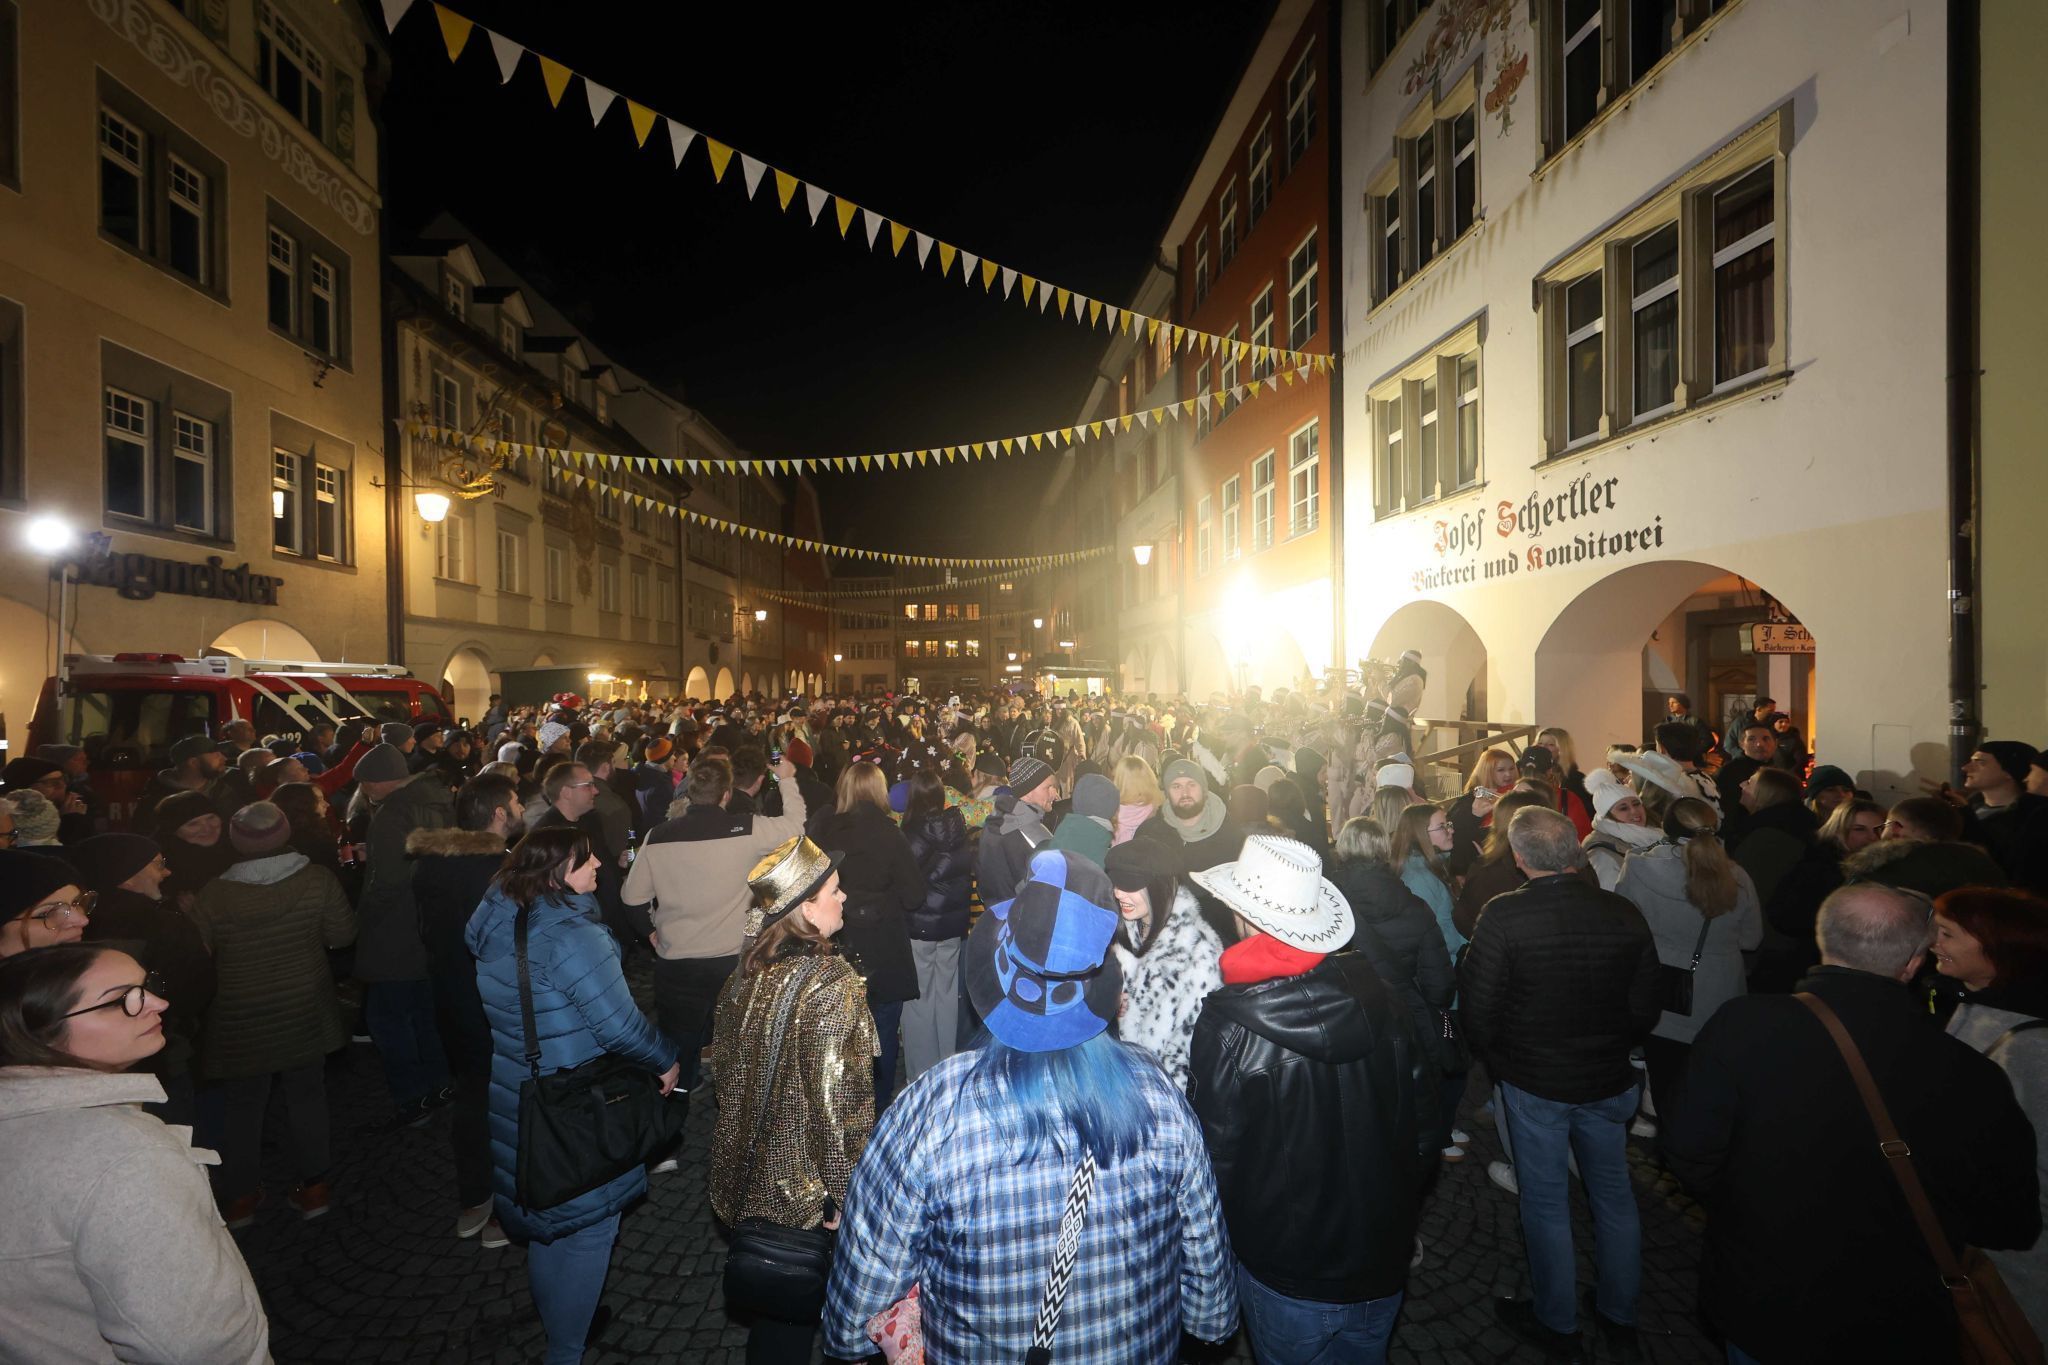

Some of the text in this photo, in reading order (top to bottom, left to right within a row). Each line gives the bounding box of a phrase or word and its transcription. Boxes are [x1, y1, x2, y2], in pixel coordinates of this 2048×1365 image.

[1410, 515, 1664, 592] Bäckerei und Konditorei
